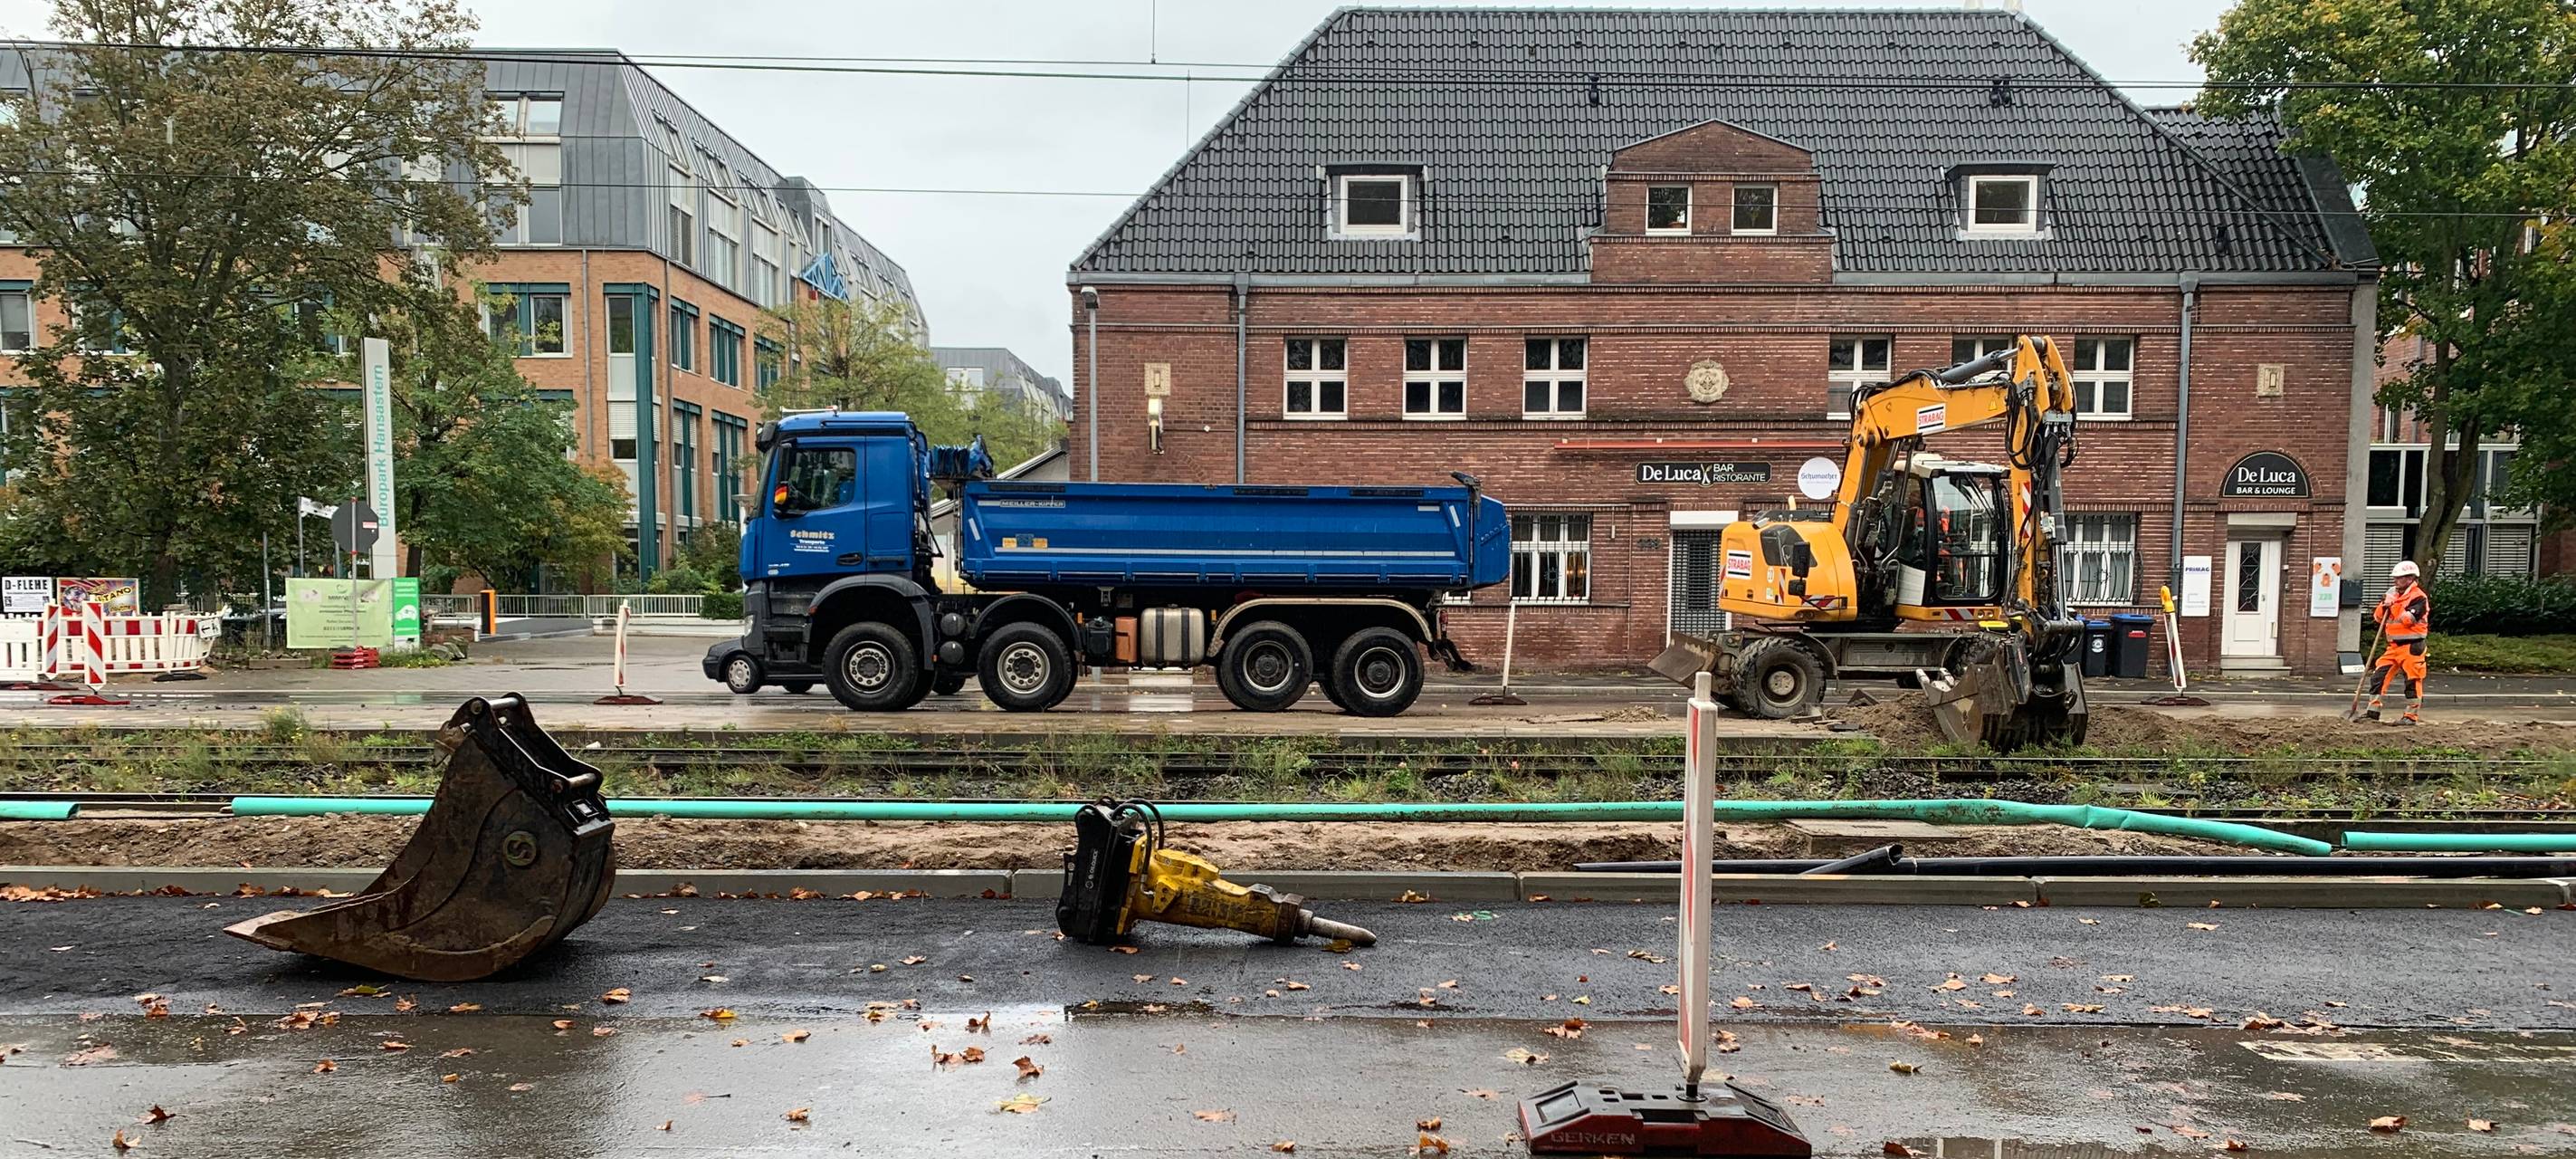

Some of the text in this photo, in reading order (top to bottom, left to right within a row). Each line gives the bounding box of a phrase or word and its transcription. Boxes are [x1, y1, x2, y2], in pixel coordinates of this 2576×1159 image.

[373, 364, 386, 454] Hansastern
[1918, 411, 1944, 426] STRABAG
[1642, 465, 1702, 482] De Luca
[1713, 464, 1734, 473] BAR
[2237, 466, 2296, 483] De Luca
[1713, 473, 1766, 482] RISTORANTE
[1801, 472, 1837, 480] Schumacher
[2236, 486, 2296, 494] BAR & LOUNGE
[789, 529, 835, 540] Schmitz
[1728, 558, 1751, 571] STRABAG
[5, 580, 48, 590] D-FLEHE
[1550, 1131, 1636, 1145] GERKEN
